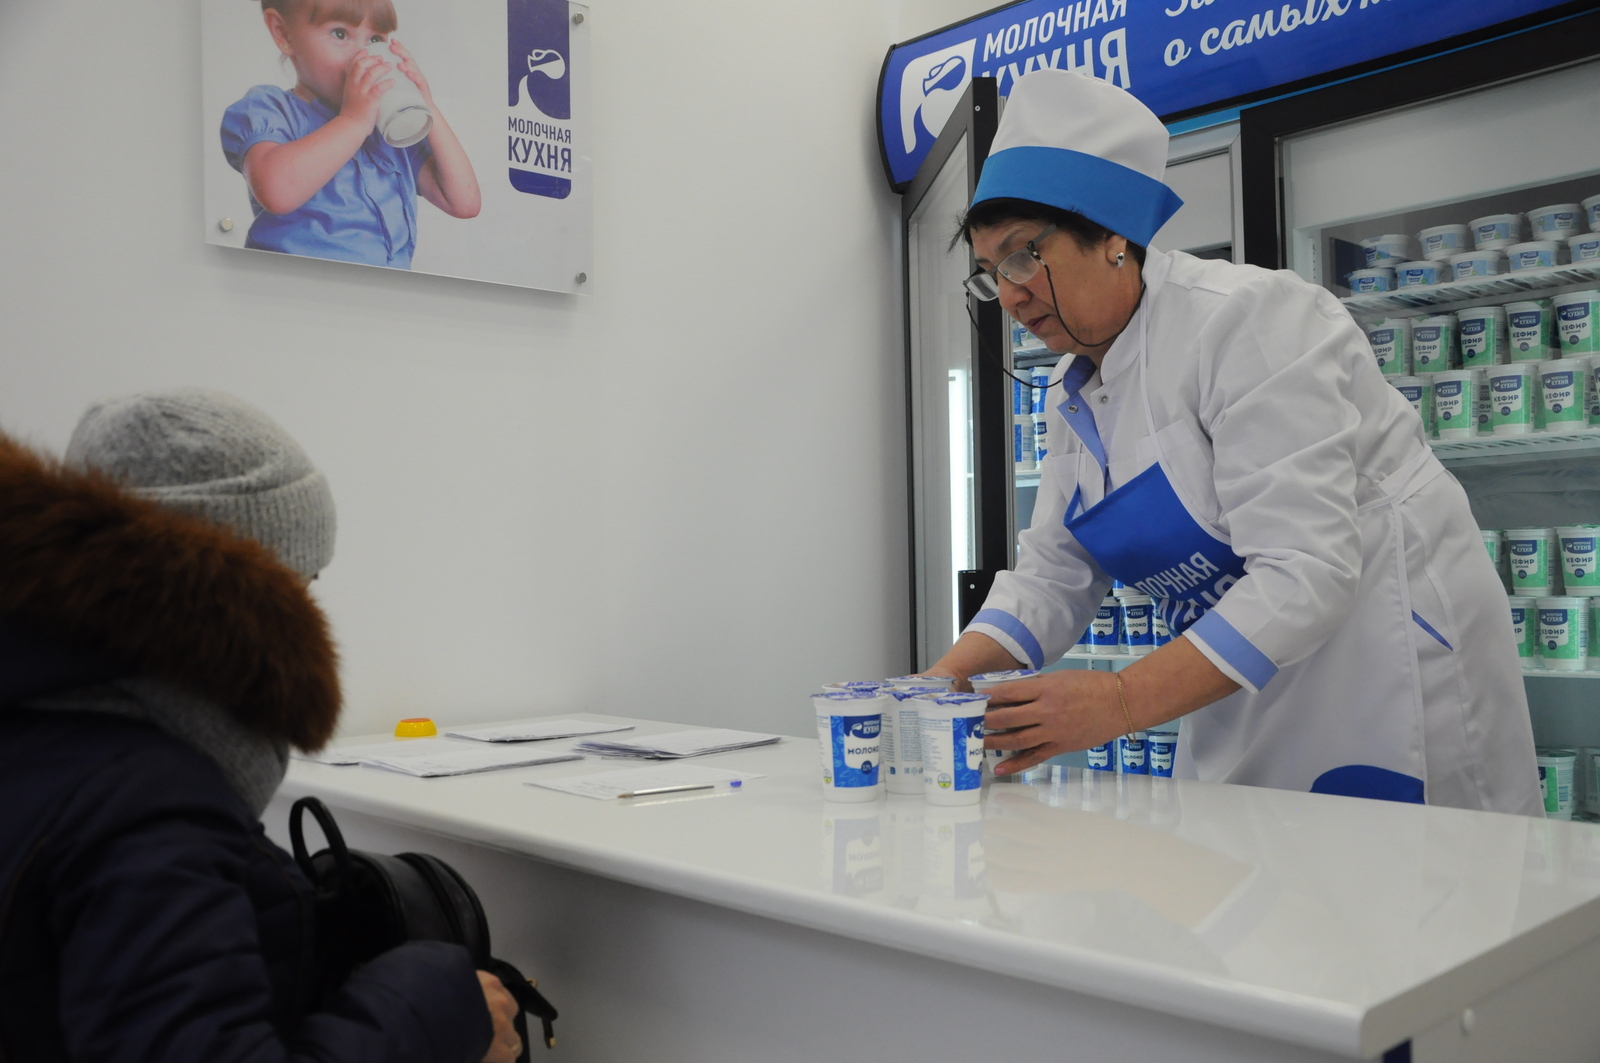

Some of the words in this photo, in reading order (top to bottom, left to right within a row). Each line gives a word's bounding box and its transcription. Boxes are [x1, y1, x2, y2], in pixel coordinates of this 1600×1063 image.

[983, 0, 1127, 62] МОЛОЧНАЯ
[508, 116, 571, 144] МОЛОЧНАЯ
[508, 135, 572, 173] КУХНЯ
[1561, 322, 1587, 331] КЕФИР
[1512, 330, 1538, 338] КЕФИР
[1373, 346, 1392, 354] ЕФИР
[1493, 394, 1519, 402] КЕФИР
[1545, 391, 1571, 399] КЕФИР
